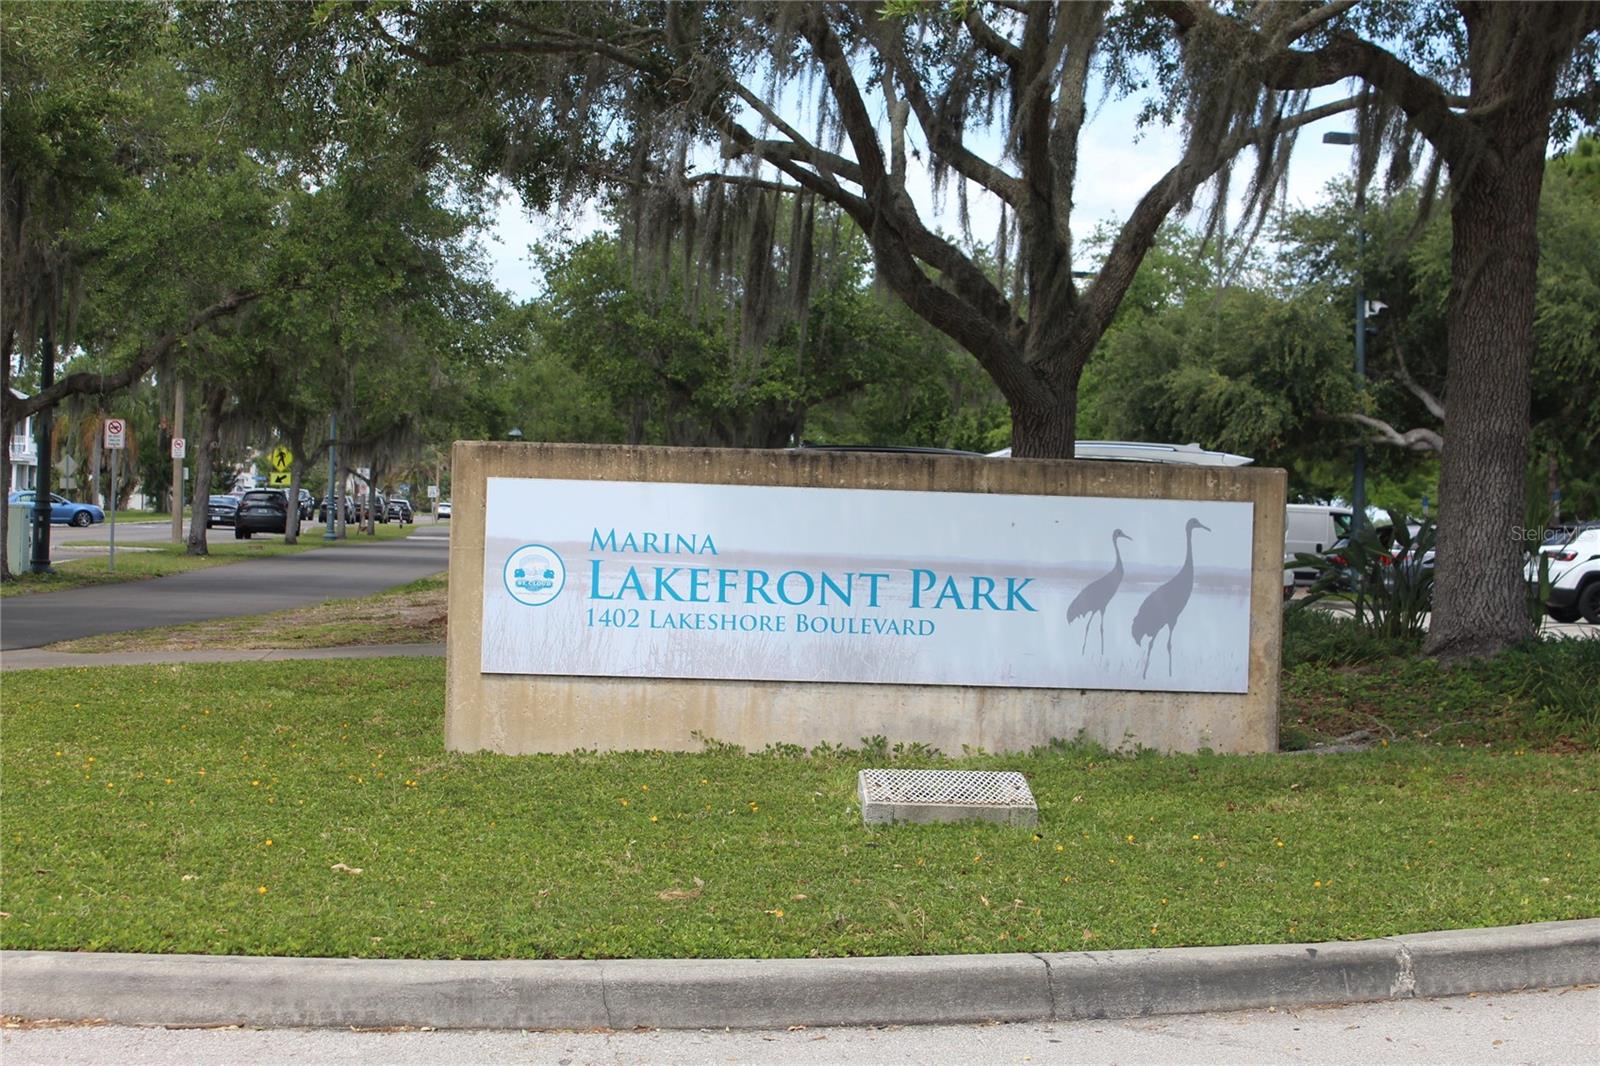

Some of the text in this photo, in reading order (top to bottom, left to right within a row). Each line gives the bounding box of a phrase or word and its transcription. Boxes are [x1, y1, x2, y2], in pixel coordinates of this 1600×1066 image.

[589, 527, 719, 555] MARINA
[589, 559, 1038, 612] LAKEFRONT PARK
[588, 607, 936, 636] 1402 LAKESHORE BOULEVARD
